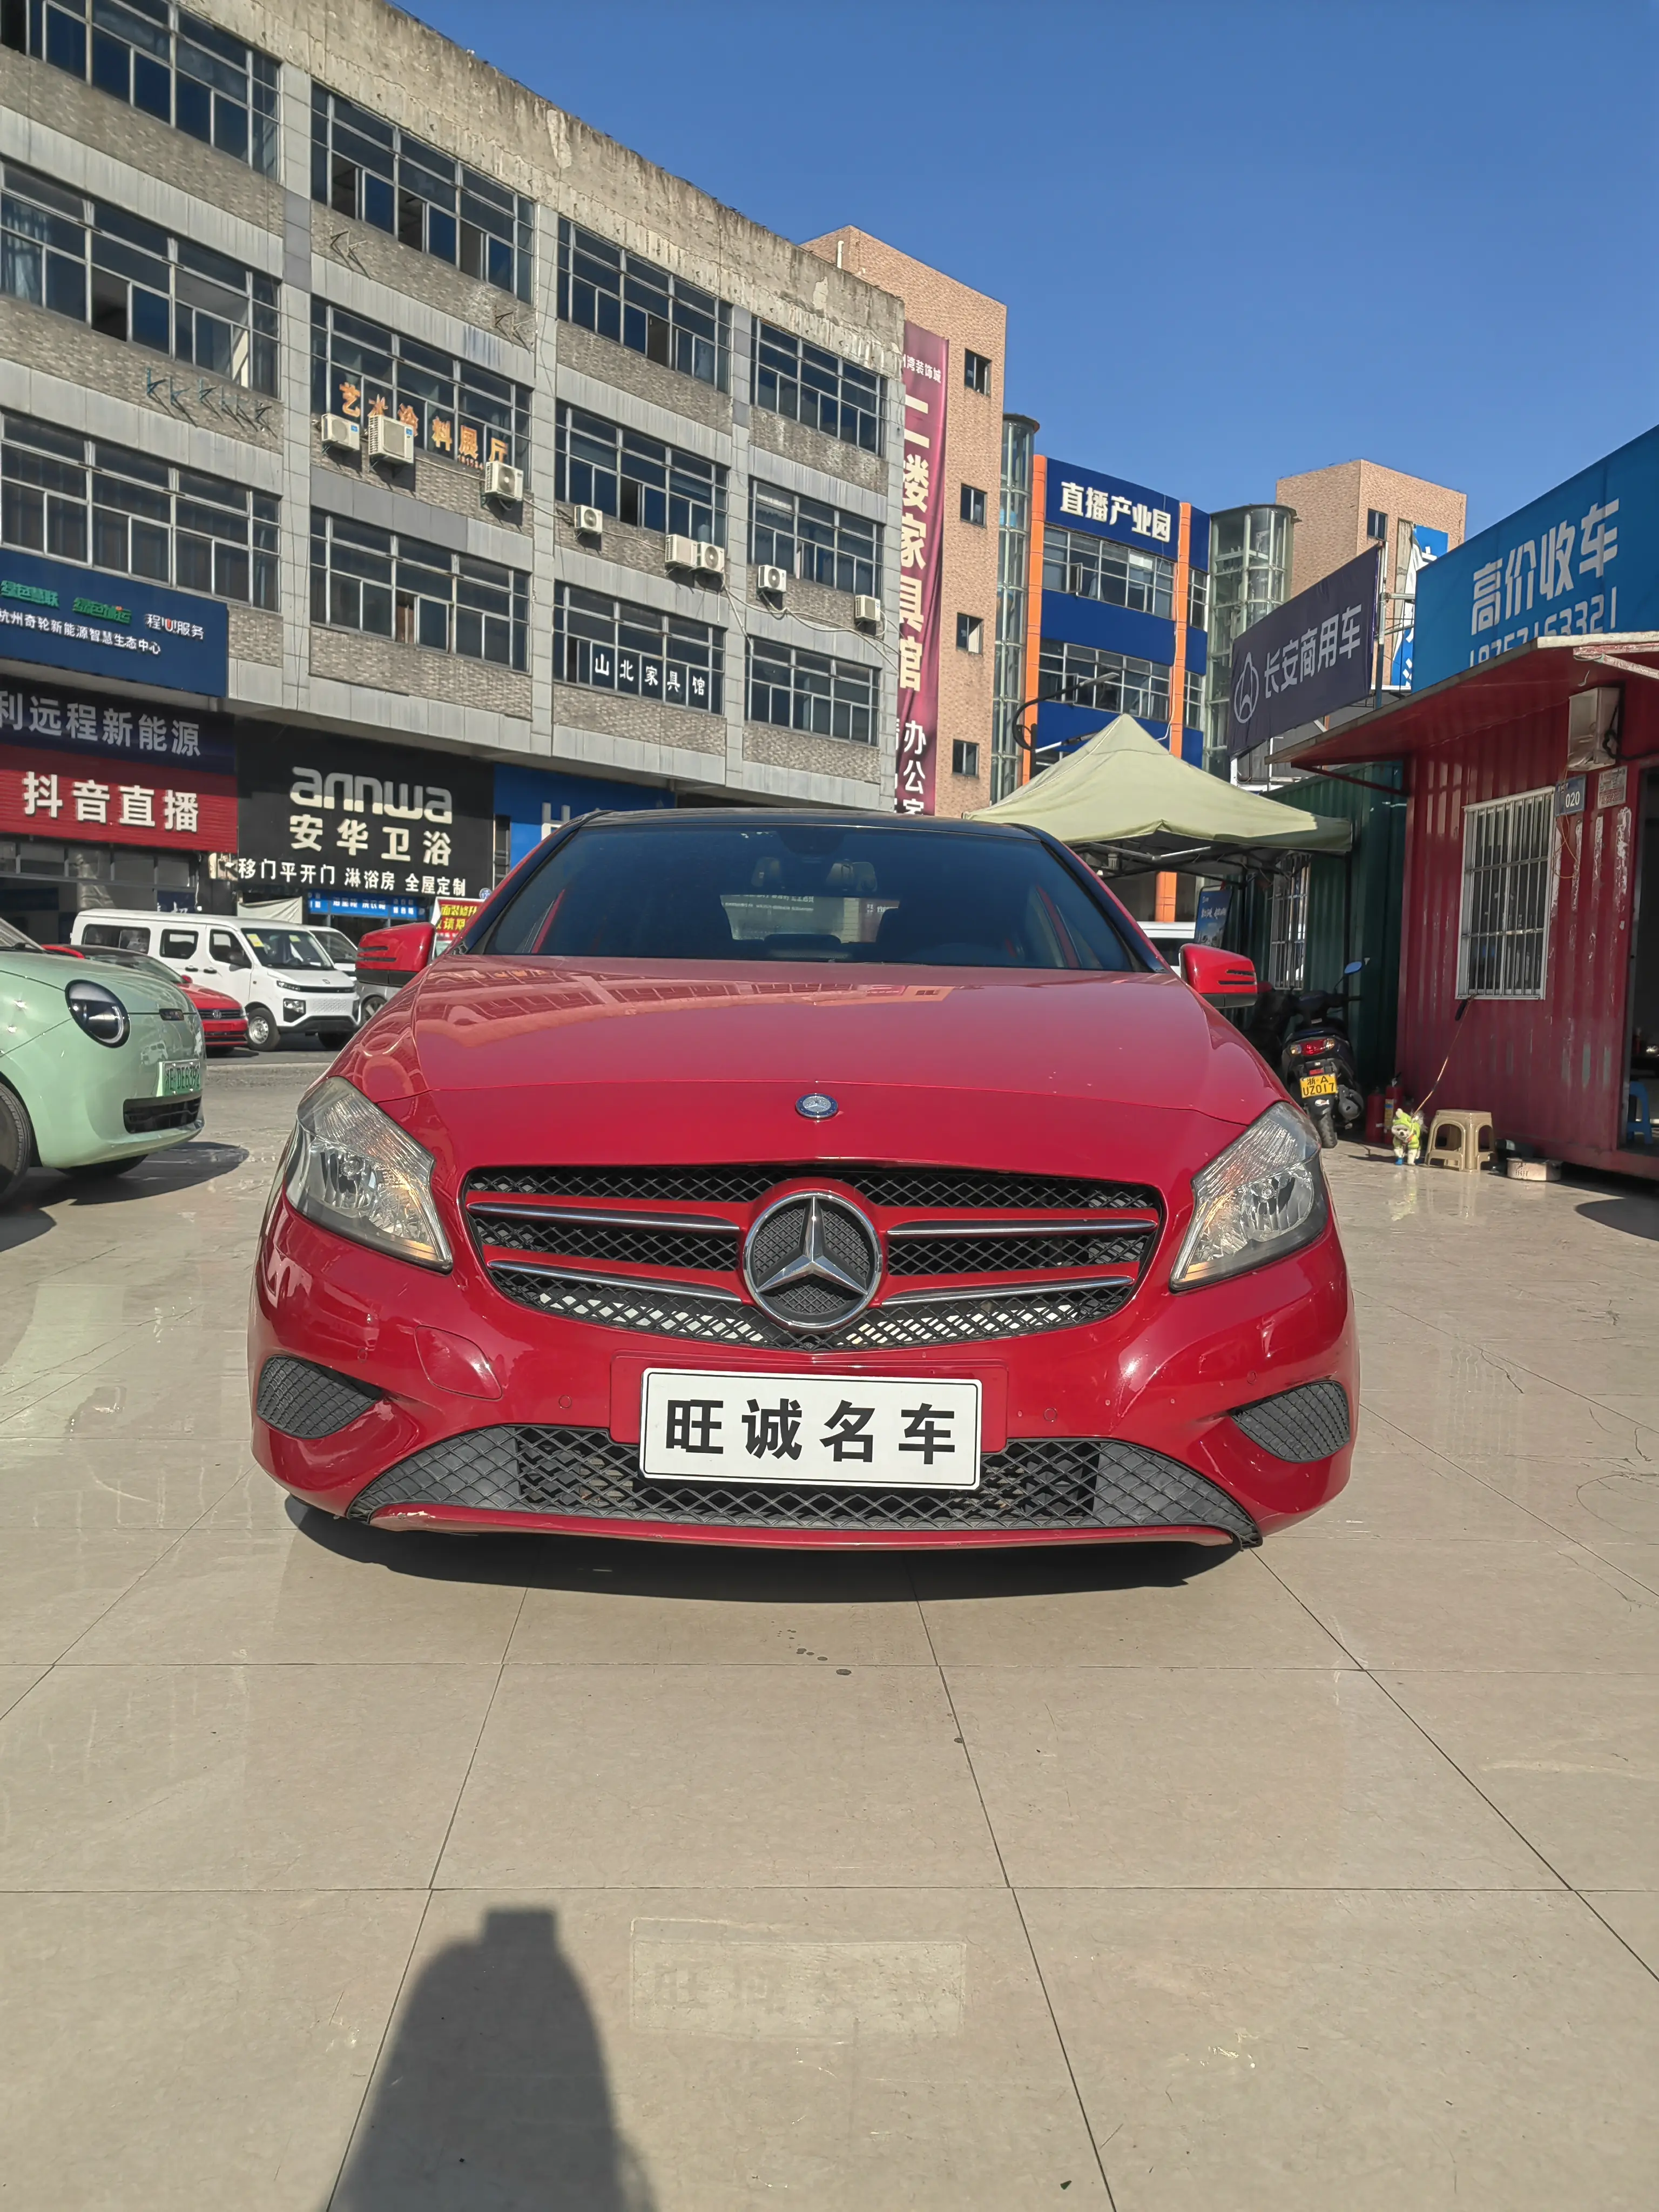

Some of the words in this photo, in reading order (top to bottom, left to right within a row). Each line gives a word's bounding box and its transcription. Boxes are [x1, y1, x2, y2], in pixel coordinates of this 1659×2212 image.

[903, 354, 941, 384] 湾装饰城
[1060, 481, 1171, 543] 直播产业园
[1471, 498, 1620, 636] 高价收车
[595, 653, 705, 696] 山北家具馆
[1264, 604, 1362, 699] 长安商用车
[0, 691, 200, 756] 利远程新能源
[22, 771, 198, 832] 抖音直播
[289, 814, 451, 866] 安华卫浴
[238, 858, 335, 885] 移门平开门
[344, 867, 395, 891] 淋浴房
[404, 873, 466, 896] 全屋定制
[1303, 1082, 1334, 1096] UZ017
[666, 1398, 955, 1465] 旺诚名车
